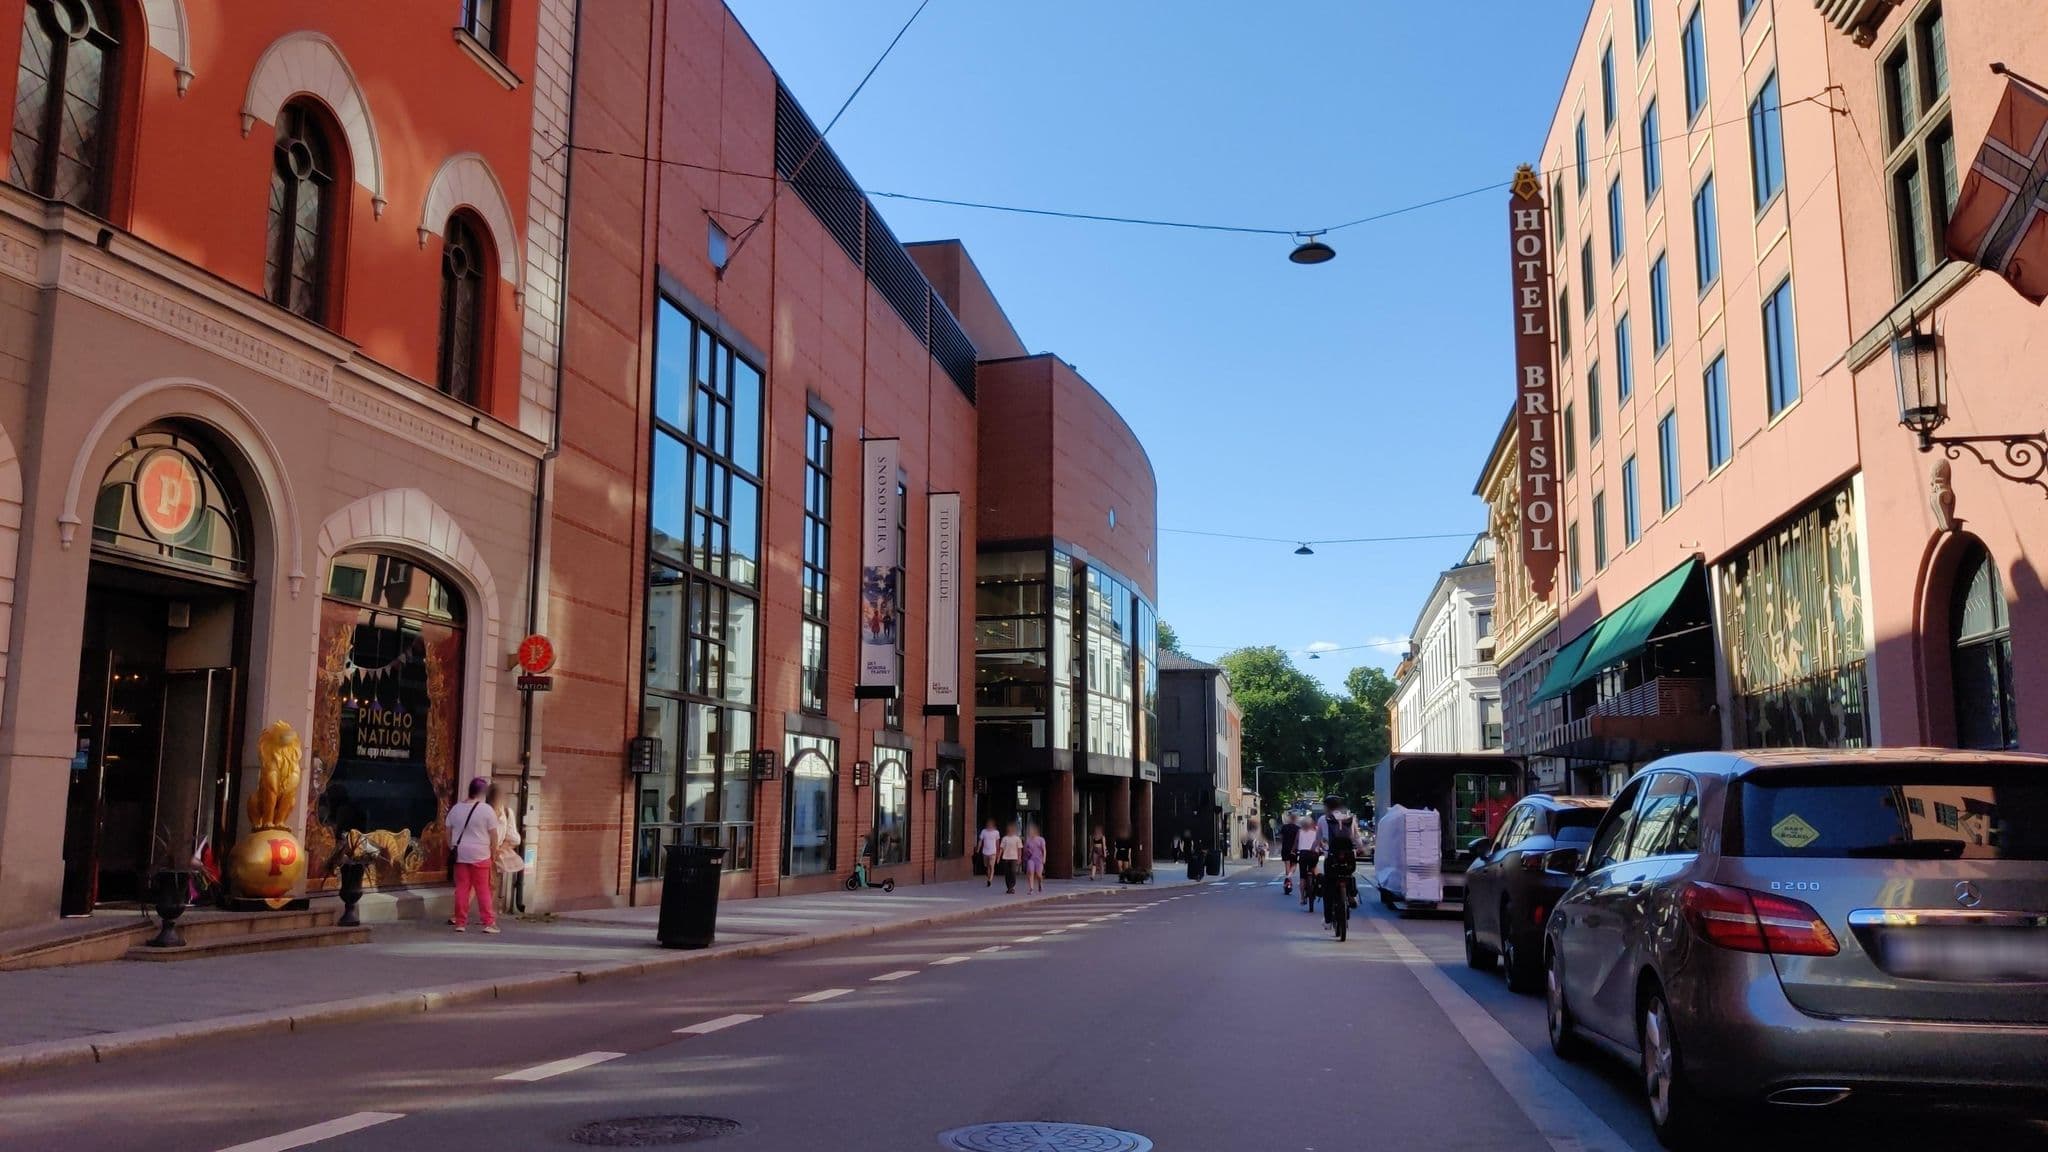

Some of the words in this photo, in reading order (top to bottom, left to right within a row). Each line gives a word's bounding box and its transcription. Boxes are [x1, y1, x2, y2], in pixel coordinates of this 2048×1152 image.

[1514, 209, 1544, 335] HOTEL
[1524, 366, 1552, 551] BRISTOL
[358, 727, 411, 746] NATION
[359, 707, 412, 728] PINCHO
